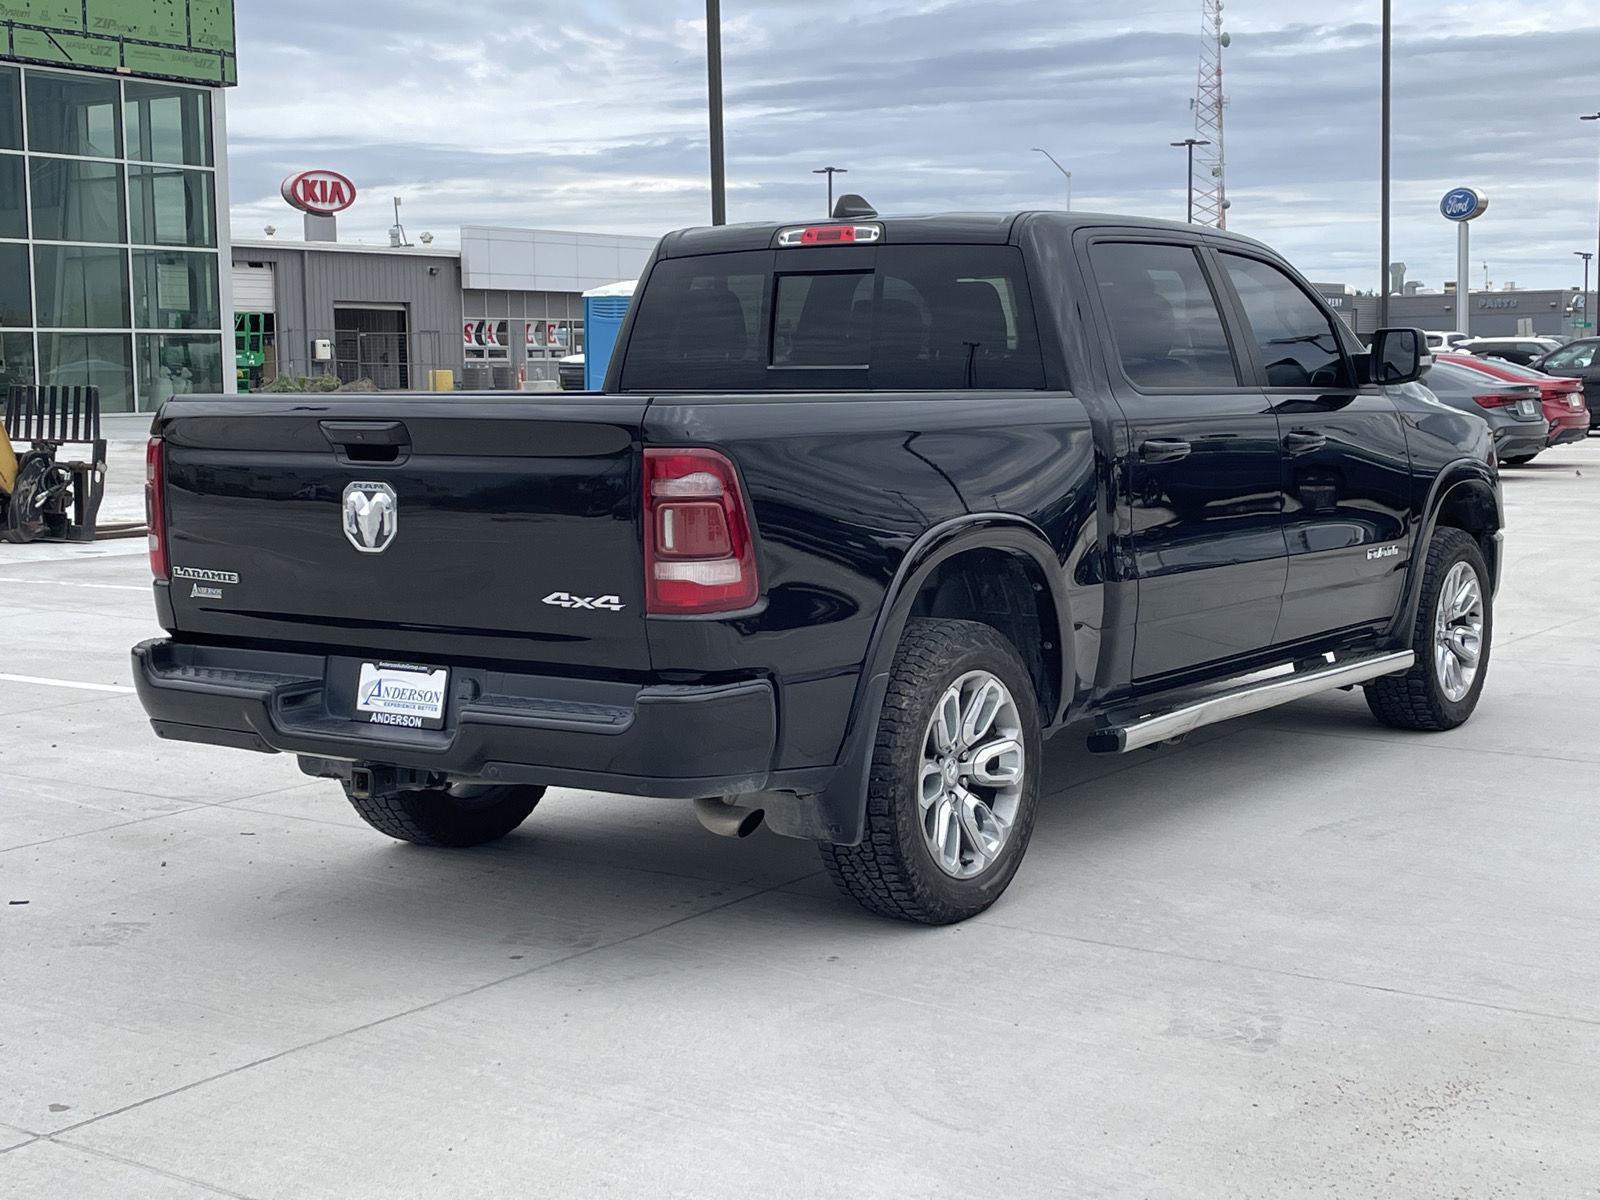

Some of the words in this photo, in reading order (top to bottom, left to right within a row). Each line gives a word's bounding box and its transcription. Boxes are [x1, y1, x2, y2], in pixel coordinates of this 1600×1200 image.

[302, 179, 346, 204] KIA
[1446, 194, 1470, 214] Ford
[173, 566, 239, 584] LARAMIE
[541, 591, 627, 611] 4x4
[362, 678, 443, 706] ANDERSON
[370, 712, 423, 728] ANDERSON
